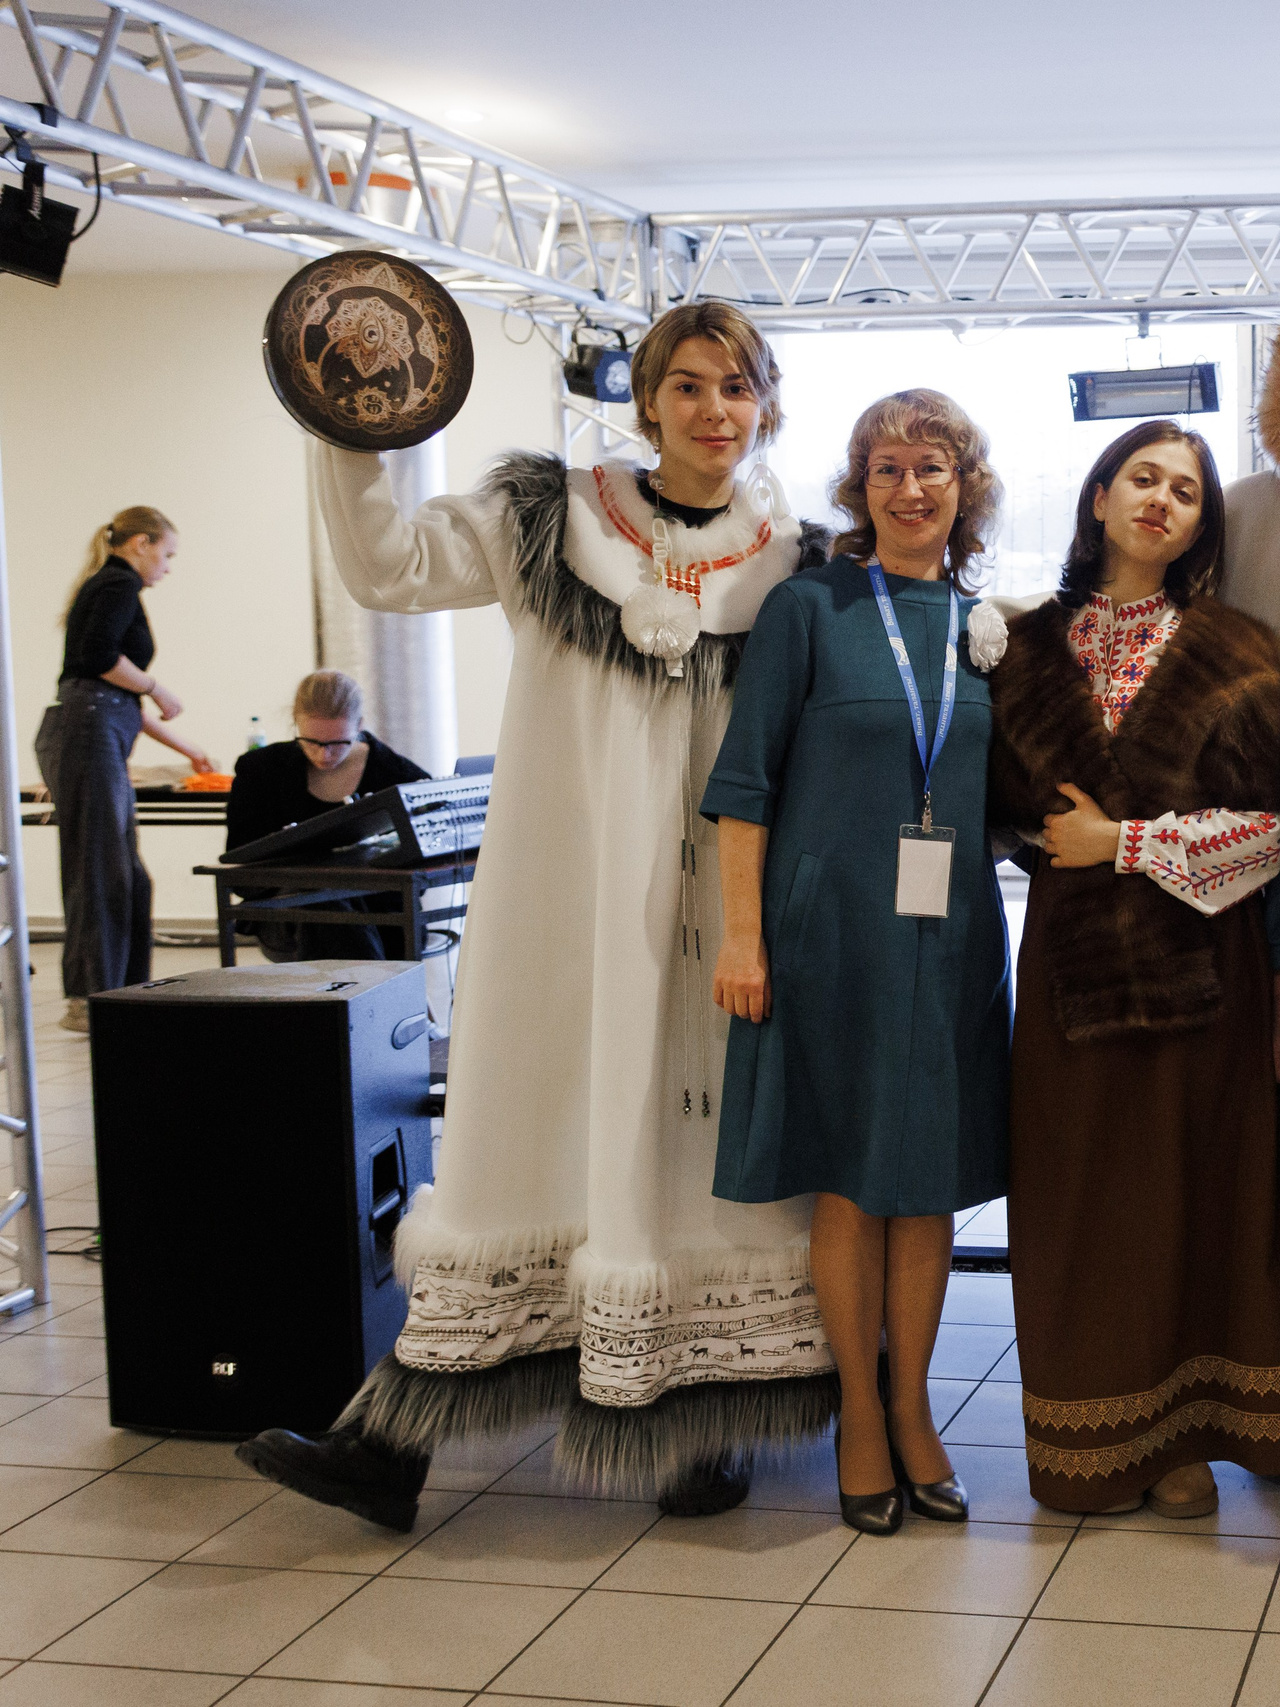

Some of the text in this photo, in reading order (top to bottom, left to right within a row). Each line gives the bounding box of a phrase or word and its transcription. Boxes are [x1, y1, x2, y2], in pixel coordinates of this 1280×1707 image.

[903, 675, 919, 710] таланты!
[939, 682, 954, 738] Виват, таланты!
[212, 1361, 237, 1376] RCF
